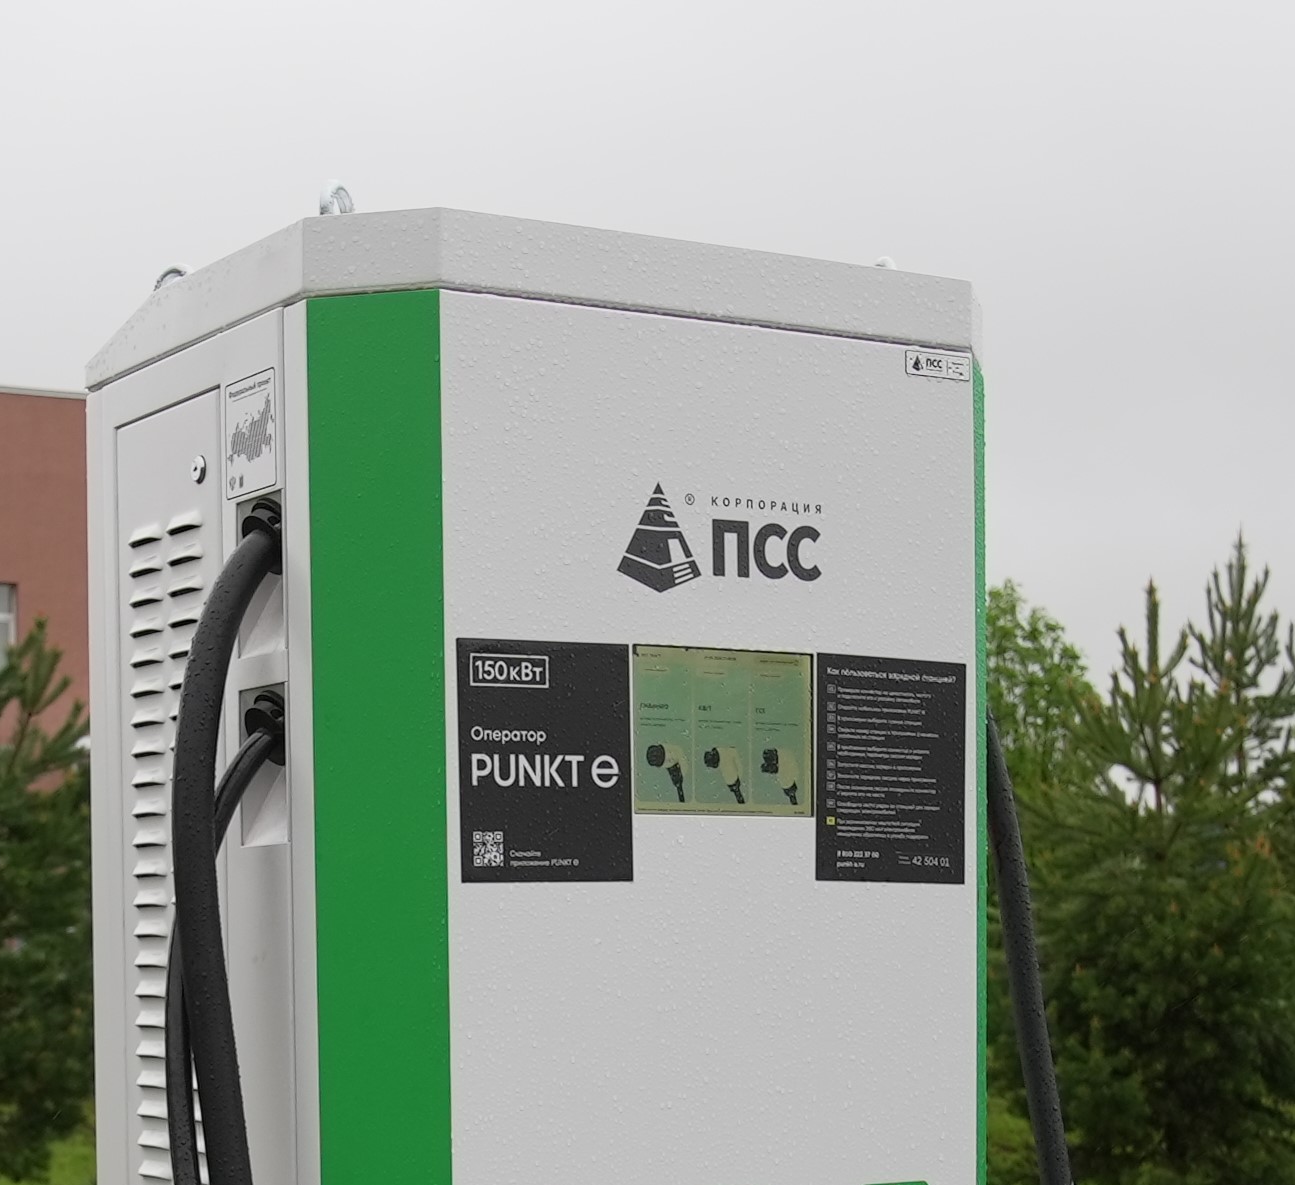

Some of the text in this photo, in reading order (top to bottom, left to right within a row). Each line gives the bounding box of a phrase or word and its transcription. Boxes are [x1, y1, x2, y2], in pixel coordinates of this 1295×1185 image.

[711, 496, 822, 515] КОРПОРАЦИЯ
[712, 518, 822, 582] ПСС
[474, 660, 544, 682] 150 кВт
[470, 725, 547, 746] Оператор
[471, 753, 585, 788] PUNKT
[911, 855, 923, 866] 42
[939, 857, 951, 868] 01
